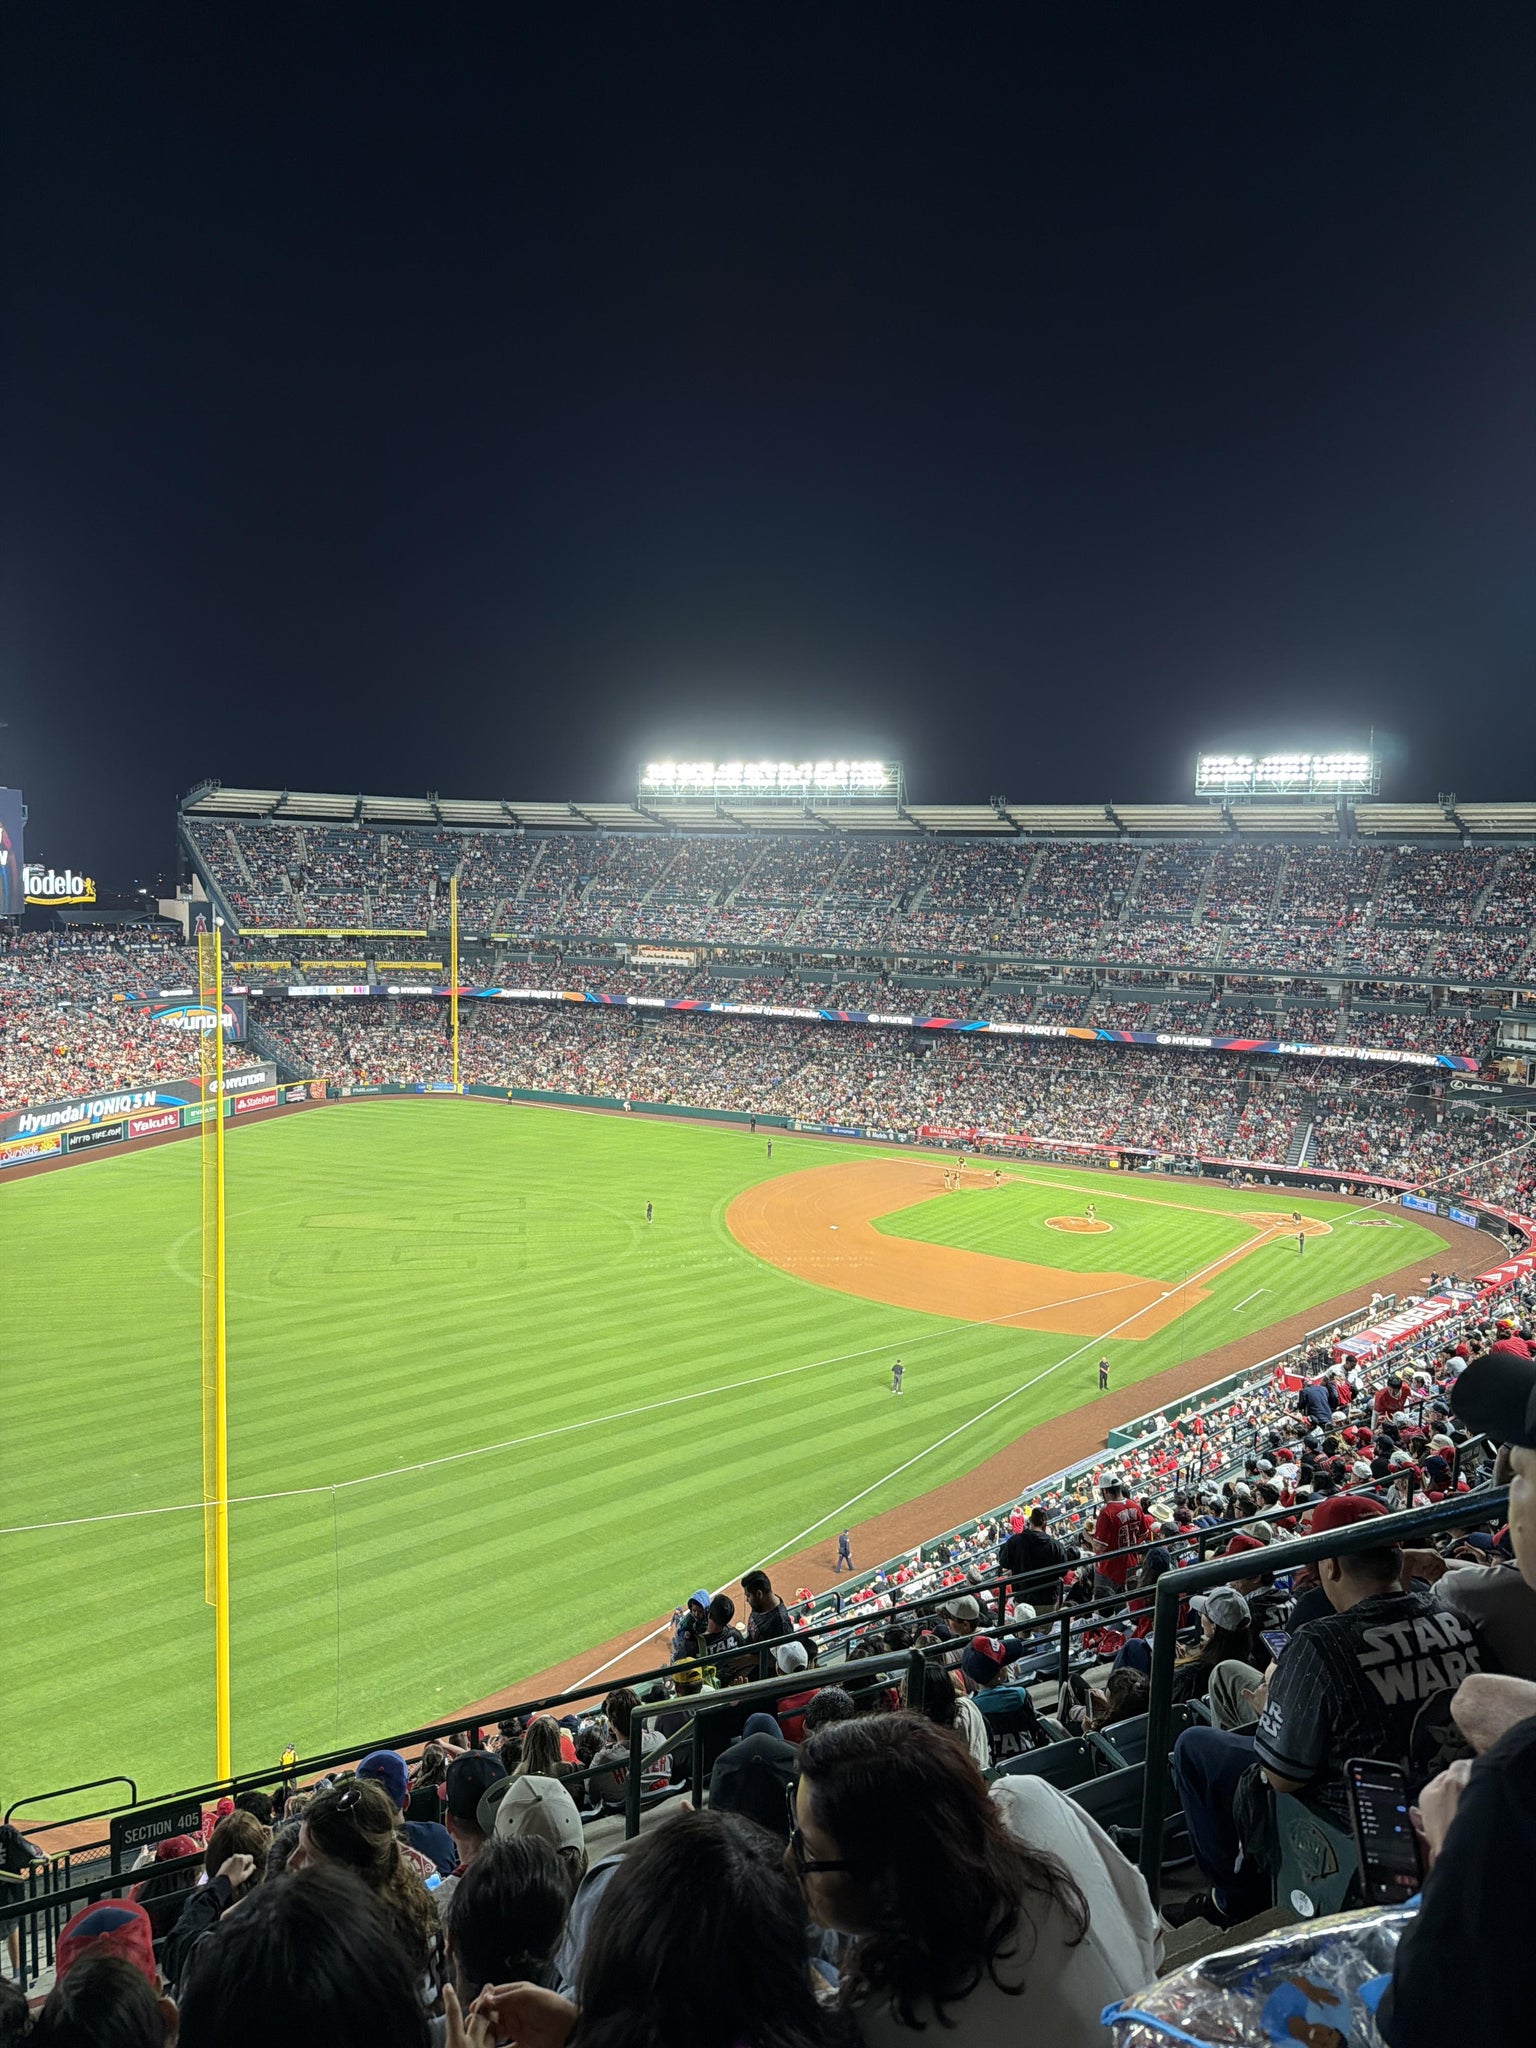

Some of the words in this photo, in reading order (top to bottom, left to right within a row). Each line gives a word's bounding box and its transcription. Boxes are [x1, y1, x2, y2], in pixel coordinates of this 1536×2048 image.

[880, 1016, 912, 1024] HYUNDAI
[1172, 1037, 1211, 1046] HYUNDAI
[1279, 1044, 1297, 1052] See
[1299, 1047, 1322, 1055] your
[1325, 1047, 1354, 1056] SoCal
[1356, 1049, 1400, 1060] Hyundai
[226, 1072, 265, 1089] HYUNDAI
[1465, 1083, 1503, 1094] LEXUS
[19, 1102, 85, 1133] Hyundai
[87, 1095, 132, 1119] IONIQ
[132, 1092, 143, 1109] 5
[144, 1091, 156, 1107] N
[133, 1115, 176, 1132] Yakult
[70, 1134, 90, 1146] NITTO
[3, 1145, 38, 1161] Surfside
[1370, 1300, 1452, 1340] ANGELS
[708, 1636, 738, 1655] TAR
[1356, 1612, 1474, 1668] STAR
[125, 1819, 172, 1844] SECTION
[177, 1812, 199, 1828] 405
